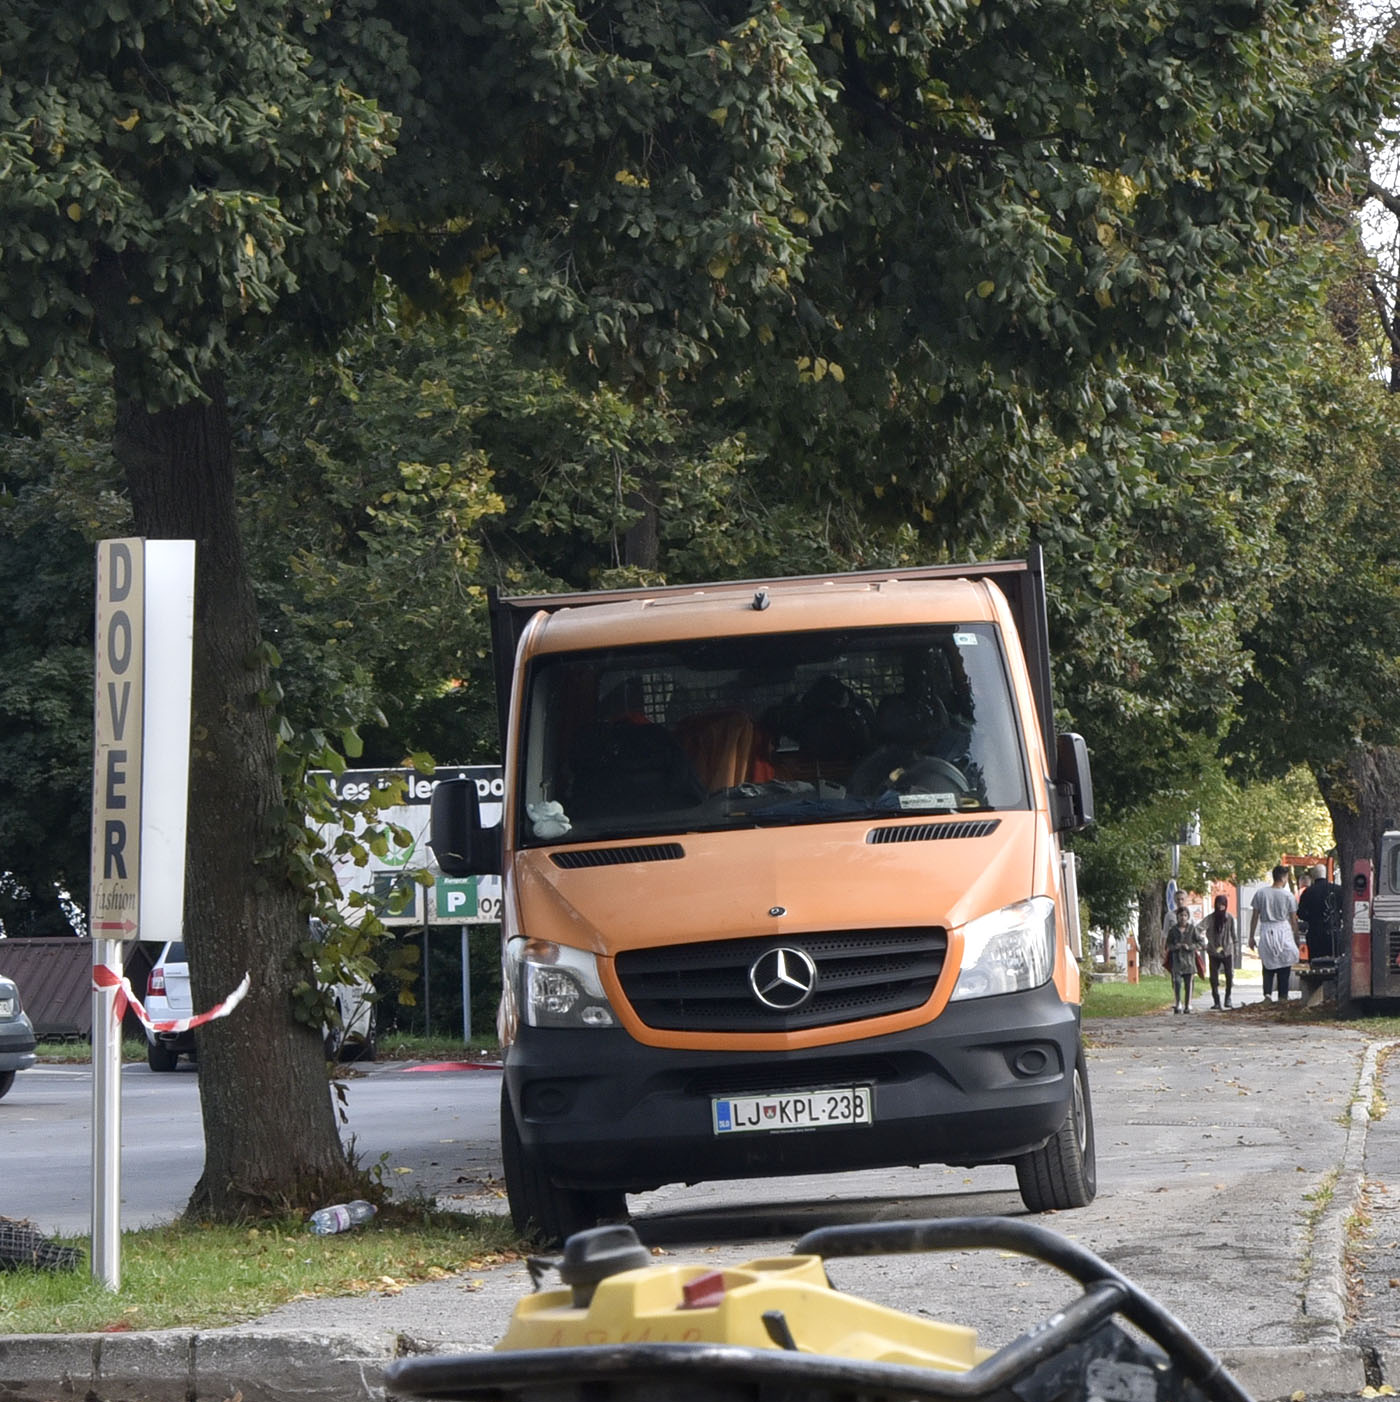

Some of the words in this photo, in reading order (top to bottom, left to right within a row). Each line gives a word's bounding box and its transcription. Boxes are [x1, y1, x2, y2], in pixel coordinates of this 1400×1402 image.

[103, 543, 132, 879] DOVER
[447, 891, 467, 913] P
[733, 1102, 761, 1126] LJ
